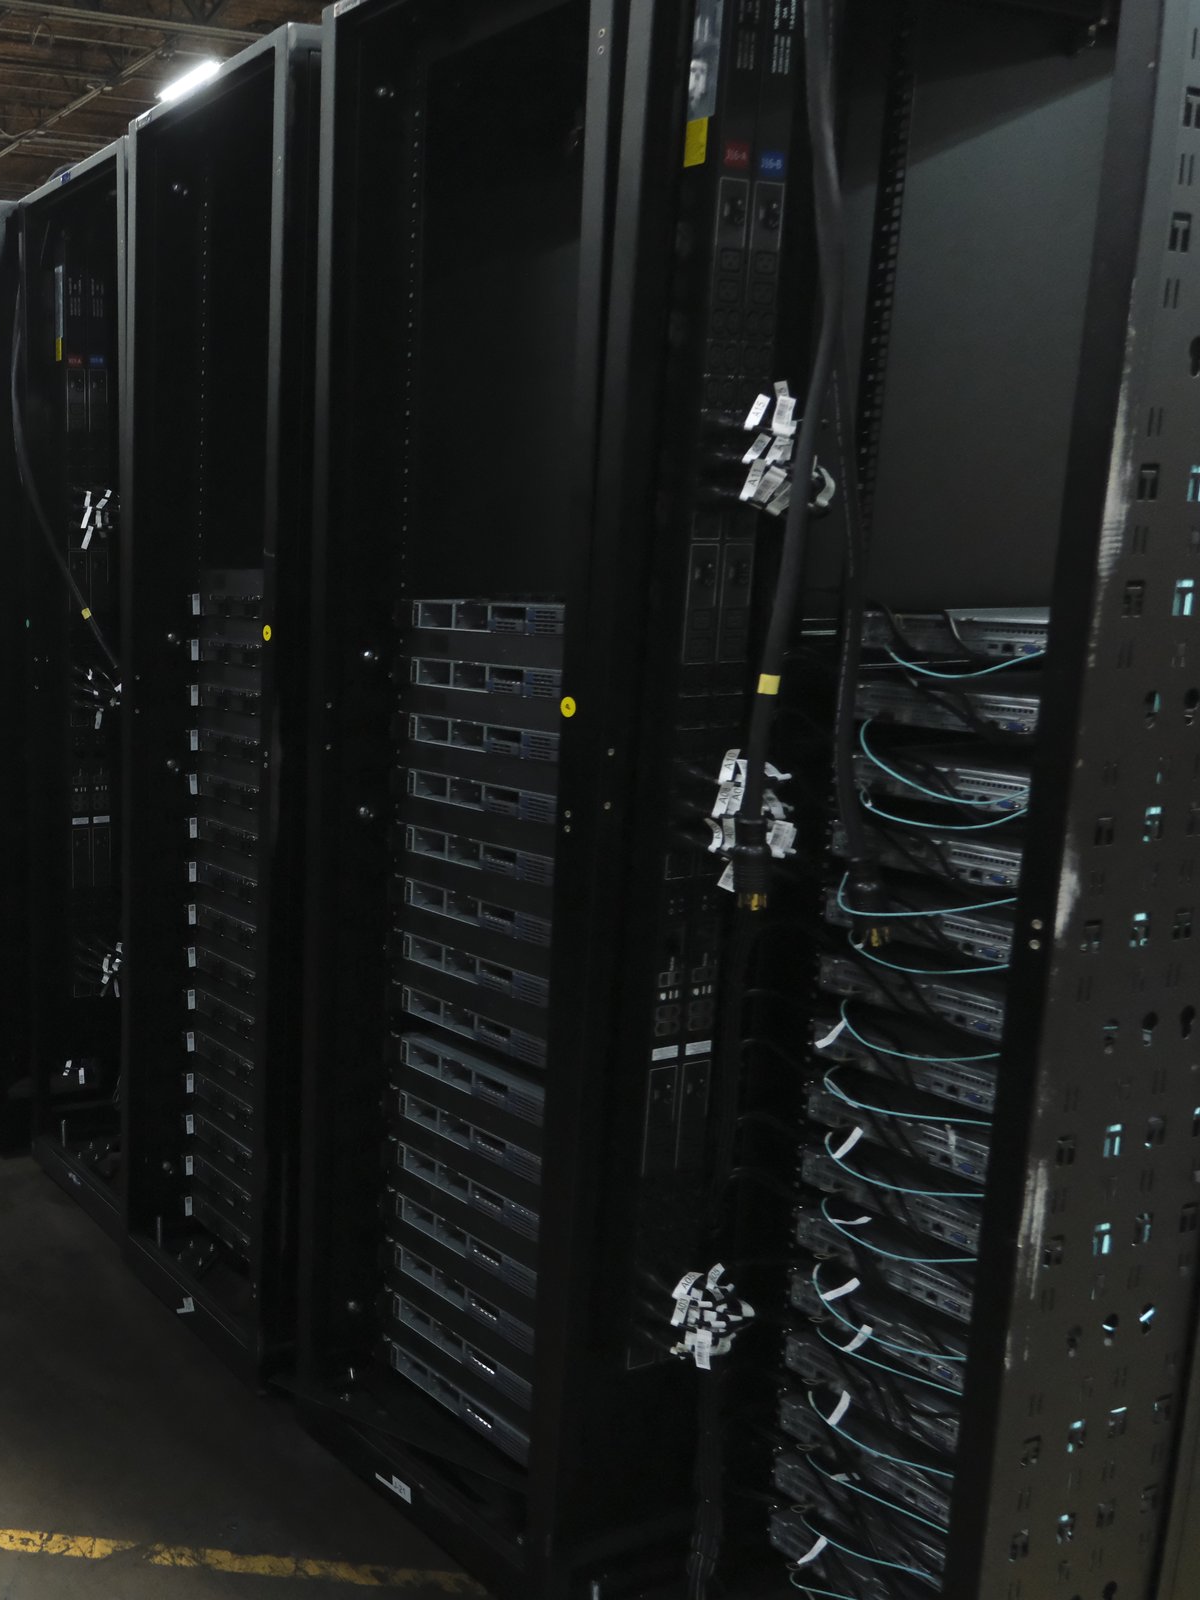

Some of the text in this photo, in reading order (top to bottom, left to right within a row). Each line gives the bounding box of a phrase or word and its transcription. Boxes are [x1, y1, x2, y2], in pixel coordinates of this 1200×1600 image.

[748, 467, 763, 486] A11
[724, 751, 737, 770] A10
[732, 787, 743, 801] A0
